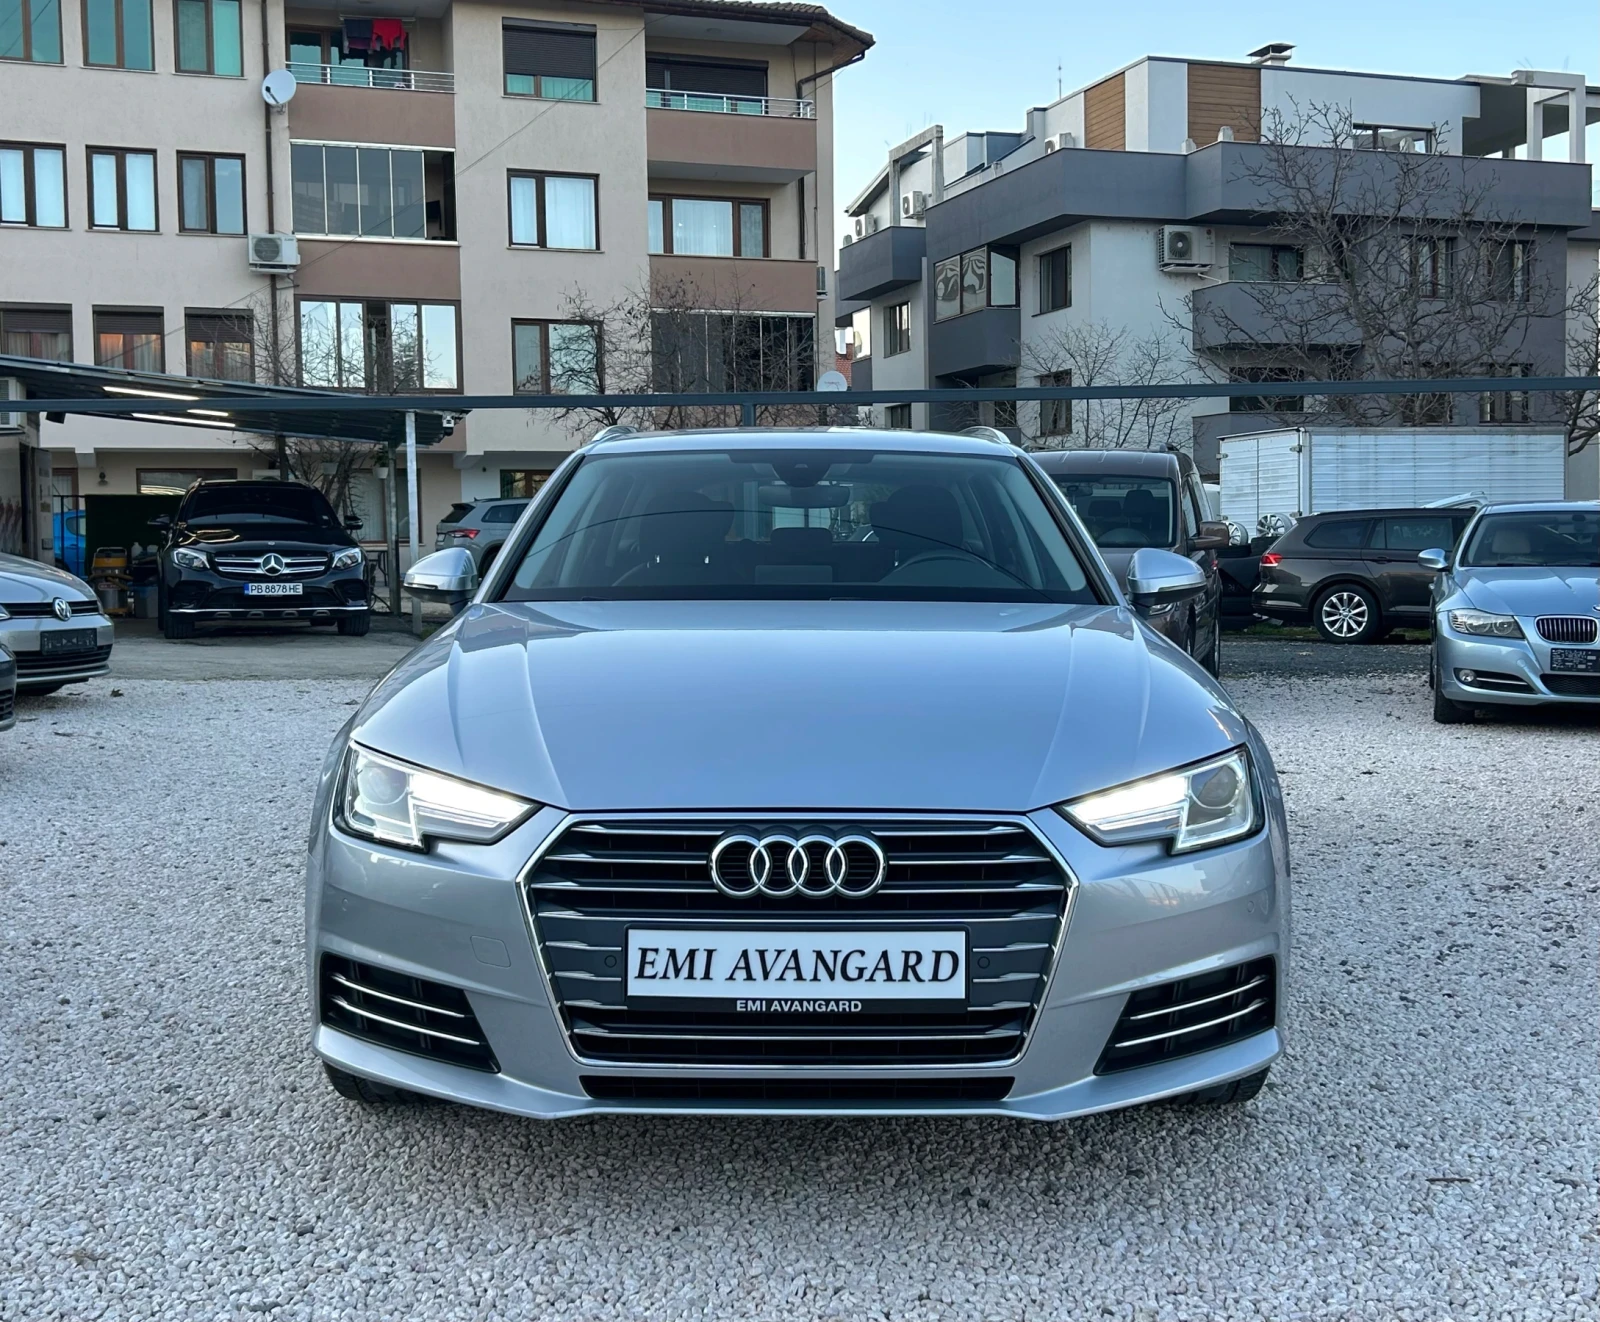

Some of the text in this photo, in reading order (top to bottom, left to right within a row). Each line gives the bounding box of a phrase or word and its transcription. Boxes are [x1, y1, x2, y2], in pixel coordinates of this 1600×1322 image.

[250, 584, 301, 594] PB 8878 HE
[634, 947, 960, 983] EMI AVANGARD
[736, 1000, 862, 1013] EMI AVANGARD
